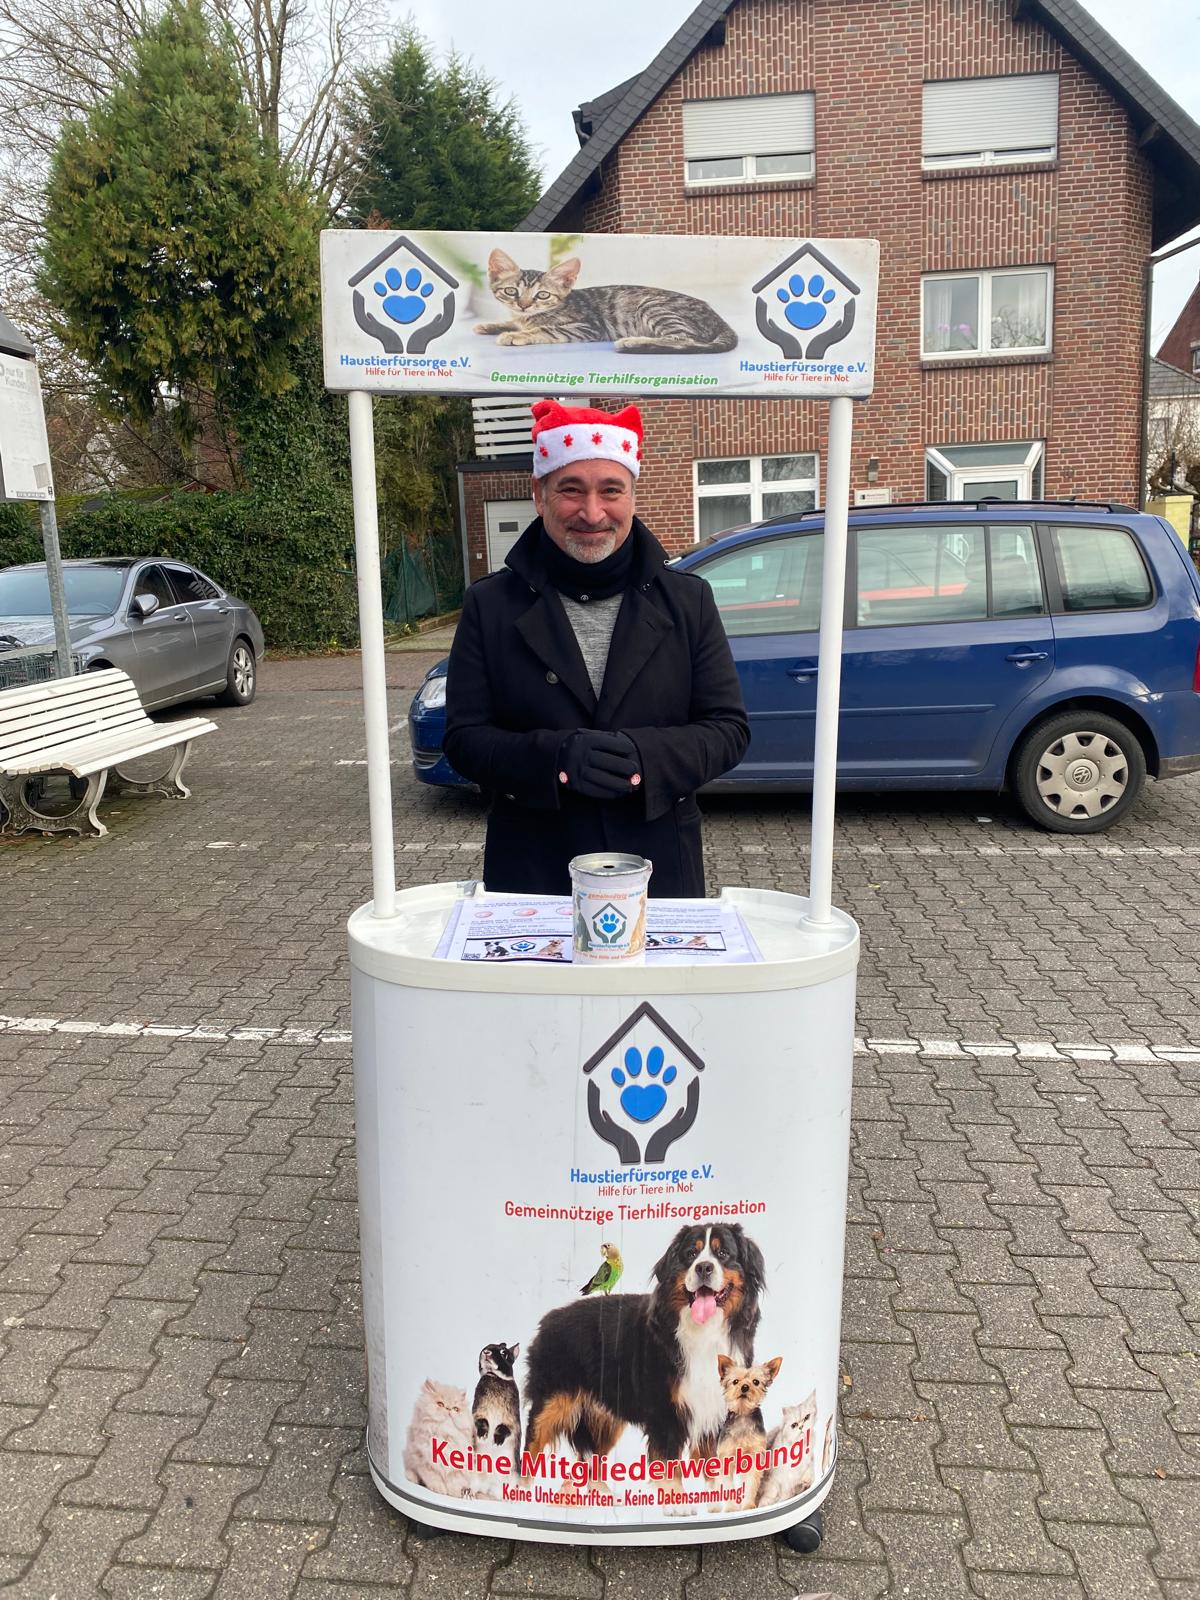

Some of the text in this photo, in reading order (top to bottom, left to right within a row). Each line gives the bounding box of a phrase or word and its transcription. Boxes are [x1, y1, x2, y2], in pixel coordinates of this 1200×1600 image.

[340, 355, 471, 369] Haustierfürsorge e.V.
[740, 361, 868, 374] Haustierfürsorge e.V.
[365, 367, 453, 377] Hilfe für Tiere in Not
[490, 371, 718, 387] Gemeinnützige Tierhilfsorganisation
[764, 373, 849, 382] Hilfe für Tiere in Not
[570, 1164, 714, 1184] Haustierfürsorge e.V.
[598, 1182, 694, 1196] Hilfe für Tiere in Not
[504, 1199, 766, 1225] Gemeinnützige Tierhilfsorganisation
[431, 1429, 811, 1487] Keine Mitgliederwerbung!
[502, 1483, 532, 1502] Keine
[534, 1486, 614, 1507] Unterschriften
[624, 1489, 655, 1506] Keine
[657, 1482, 745, 1506] Datensammlung!
